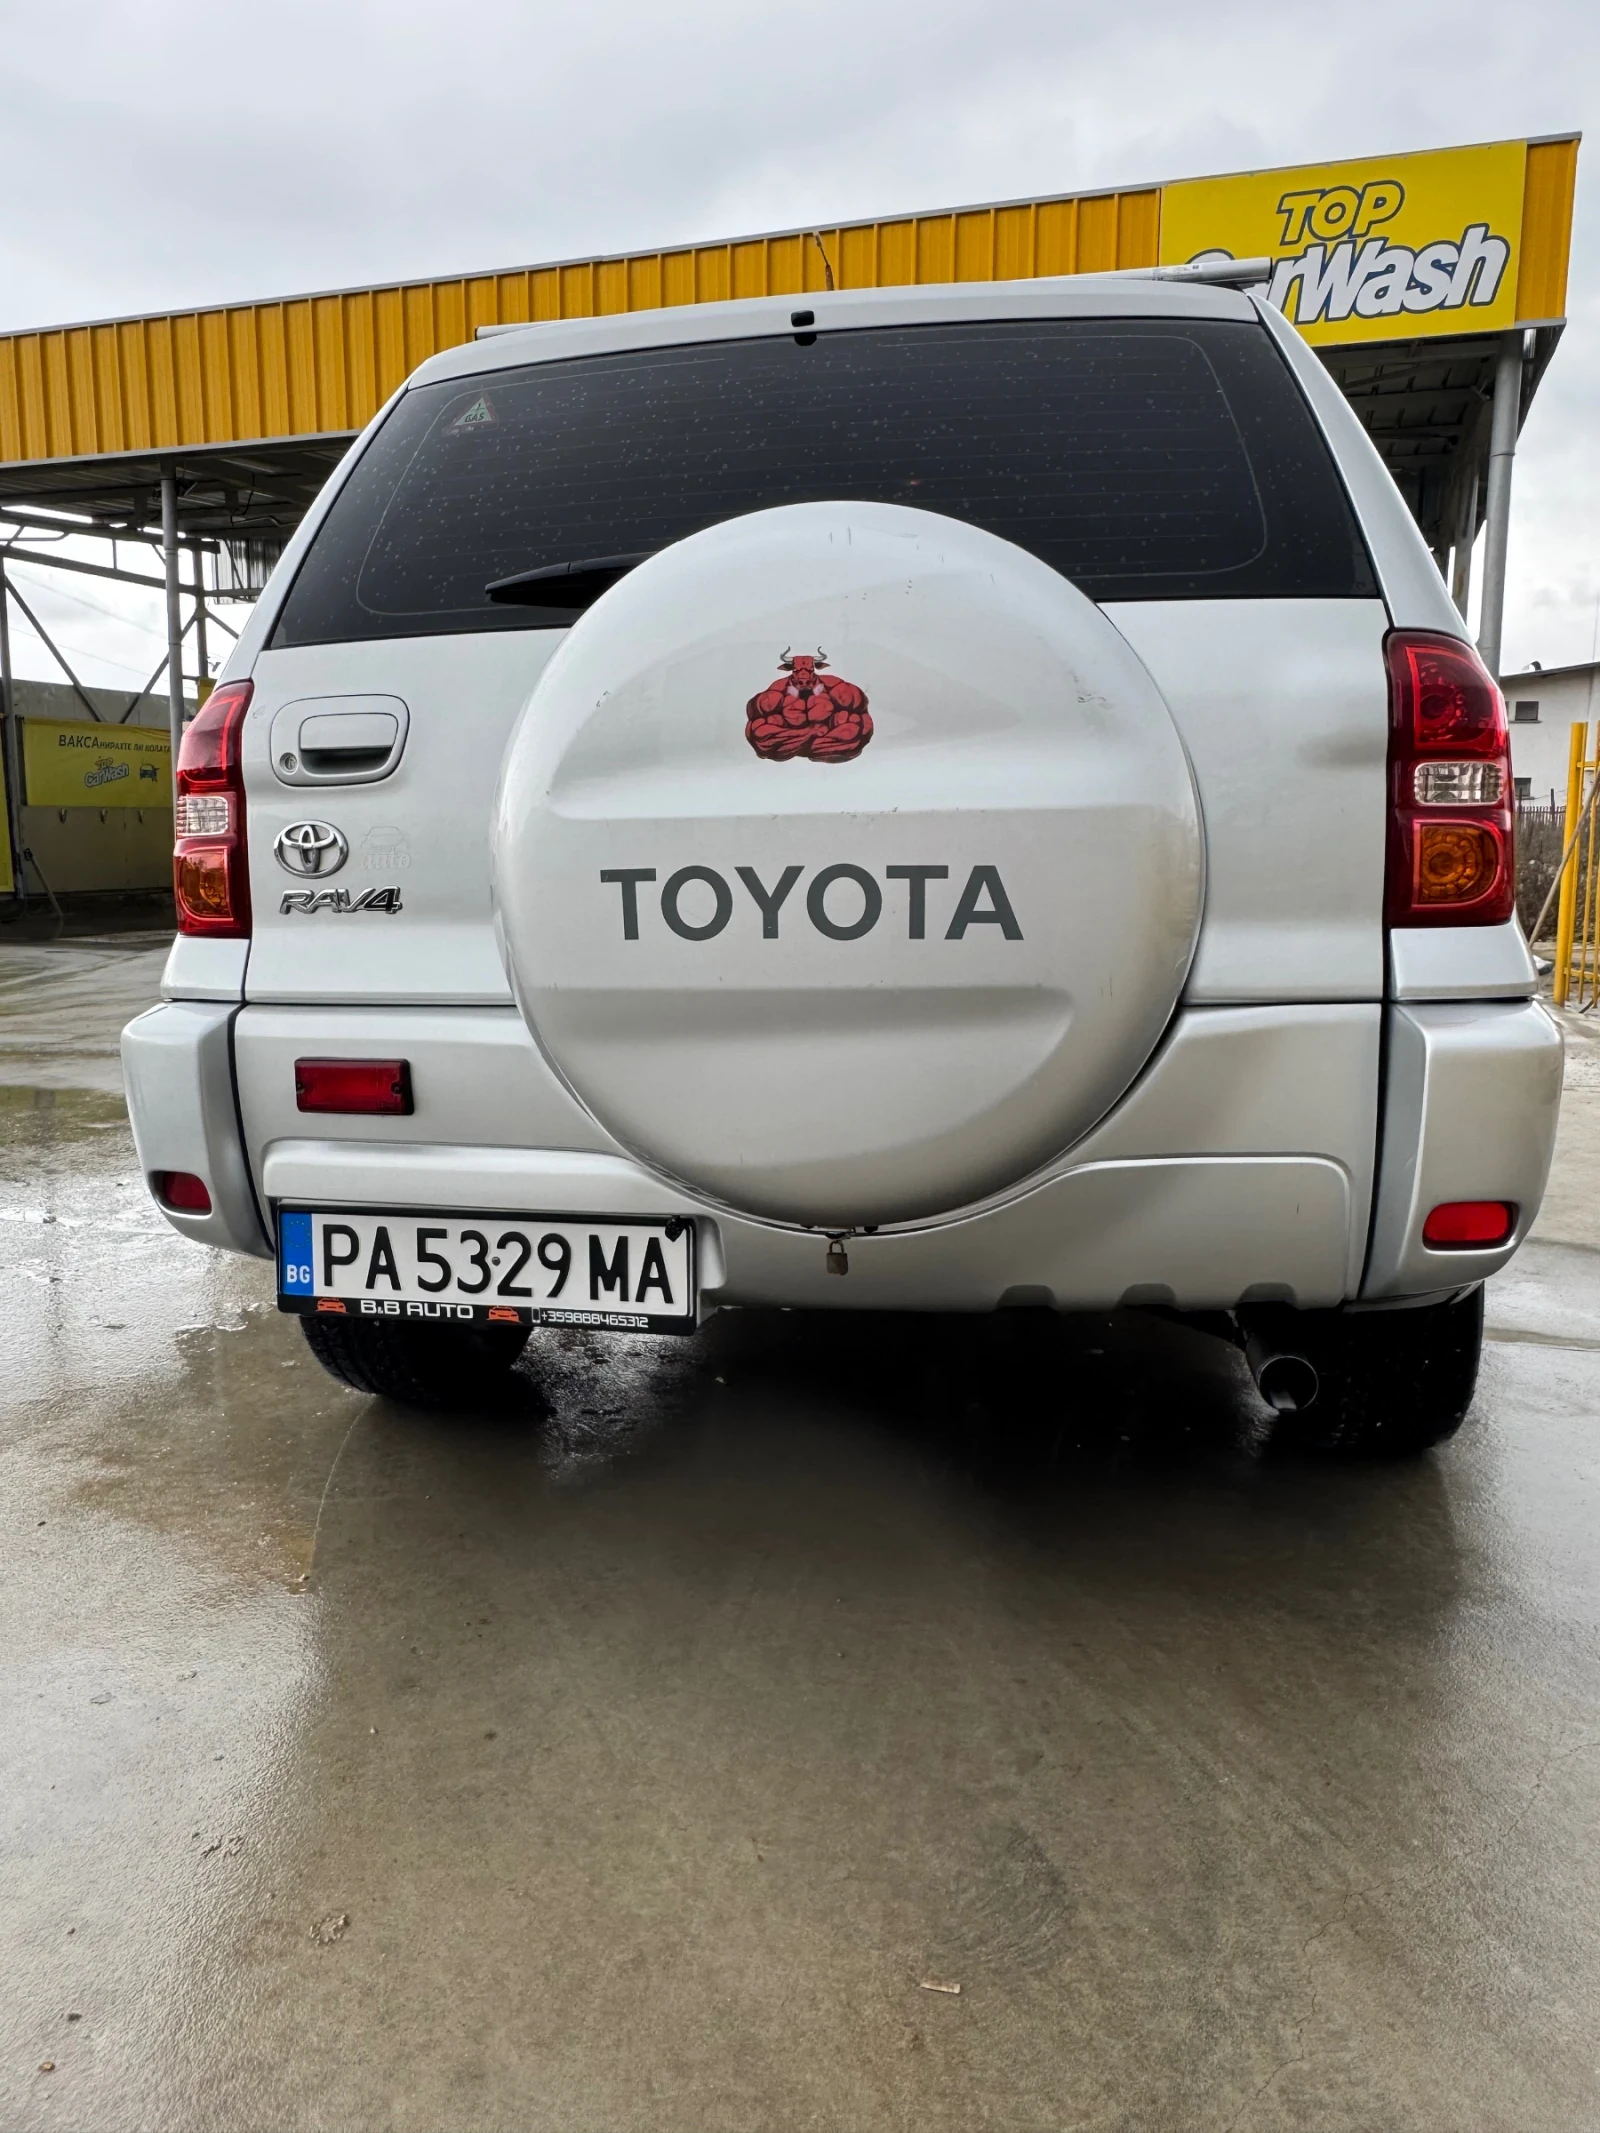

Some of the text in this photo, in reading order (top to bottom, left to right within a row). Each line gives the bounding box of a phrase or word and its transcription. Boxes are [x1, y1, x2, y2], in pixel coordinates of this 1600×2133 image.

[1276, 179, 1405, 247] TOP
[279, 885, 404, 915] RAV4
[600, 863, 1025, 942] TOYOTA
[286, 1263, 311, 1285] BG
[322, 1223, 675, 1305] PA 5329 MA
[360, 1299, 401, 1315] B&B
[406, 1301, 474, 1319] AUTO
